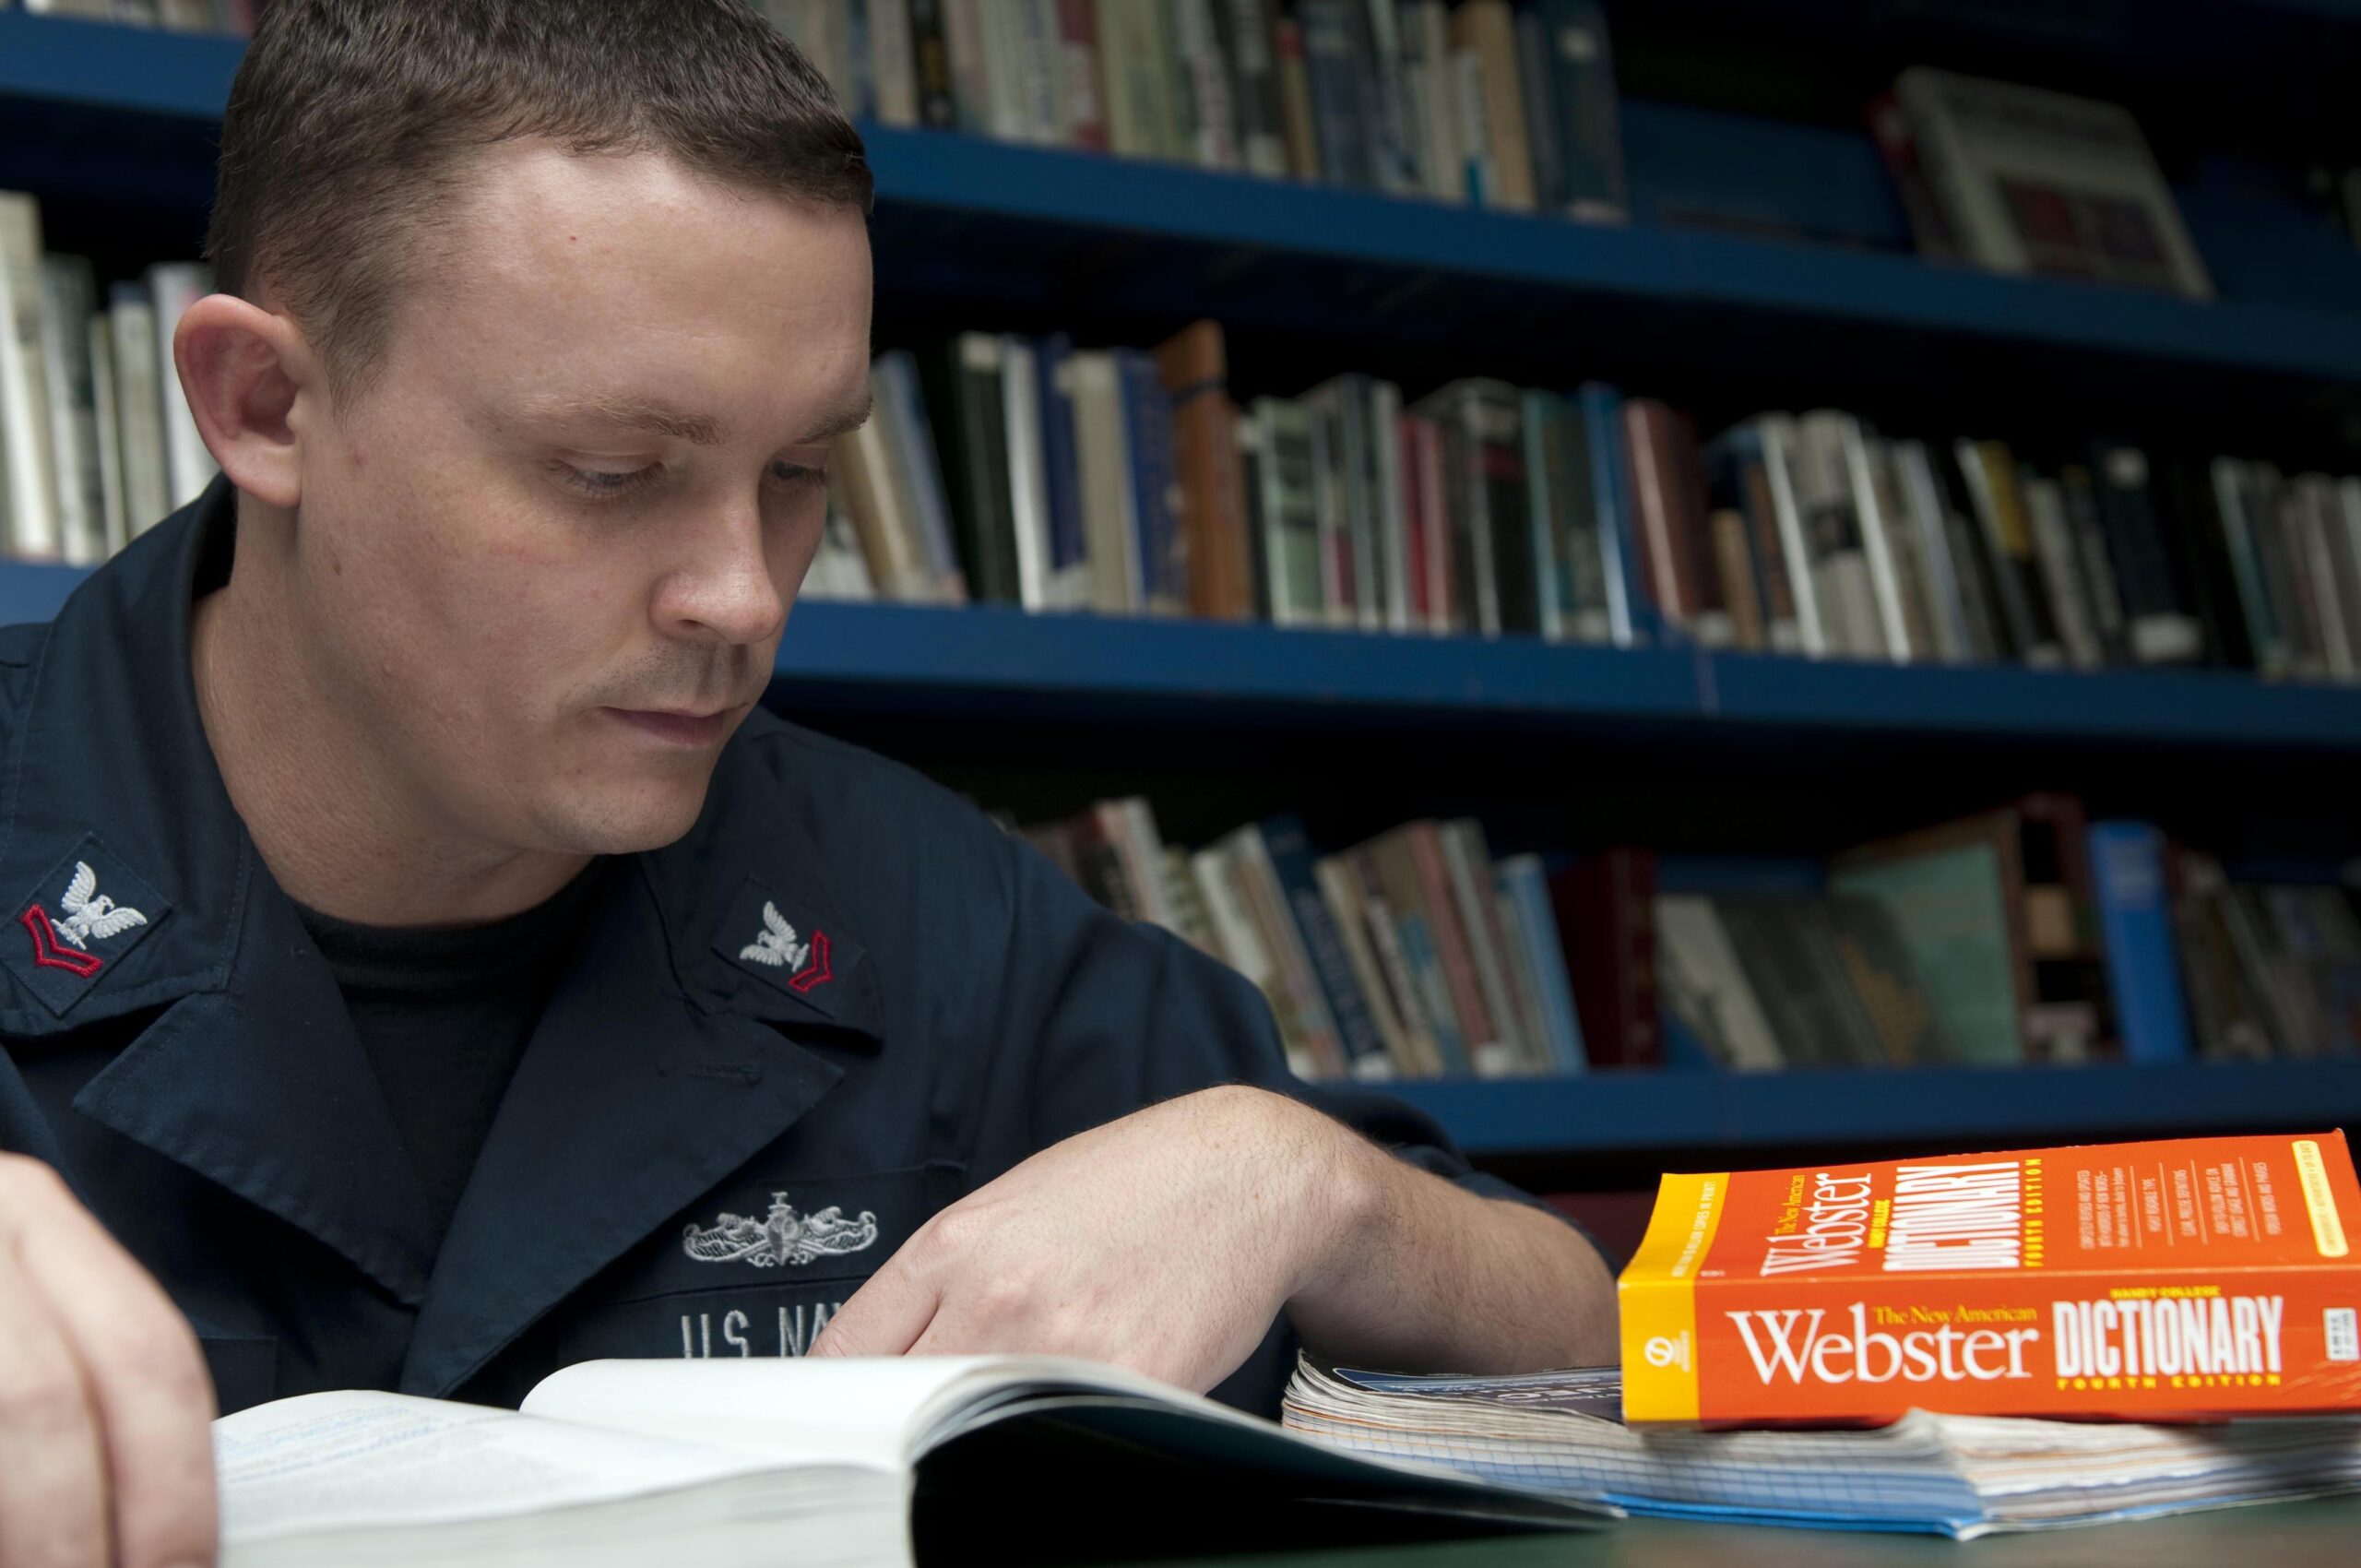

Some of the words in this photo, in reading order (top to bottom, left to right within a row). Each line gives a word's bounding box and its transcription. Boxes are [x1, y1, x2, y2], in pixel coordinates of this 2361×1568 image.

[1785, 1174, 1805, 1206] American
[2024, 1158, 2043, 1214] EDITION
[1759, 1172, 1872, 1277] Webster
[1882, 1161, 2021, 1271] DICTIONARY
[2024, 1219, 2044, 1267] FOURTH
[778, 1301, 842, 1359] NA
[1872, 1305, 1907, 1325] The
[1910, 1305, 1951, 1325] New
[1953, 1303, 2038, 1324] American
[2051, 1295, 2284, 1377] DICTIONARY
[1725, 1301, 2040, 1386] Webster
[2057, 1376, 2157, 1391] FOURTH
[2171, 1373, 2282, 1388] EDITION
